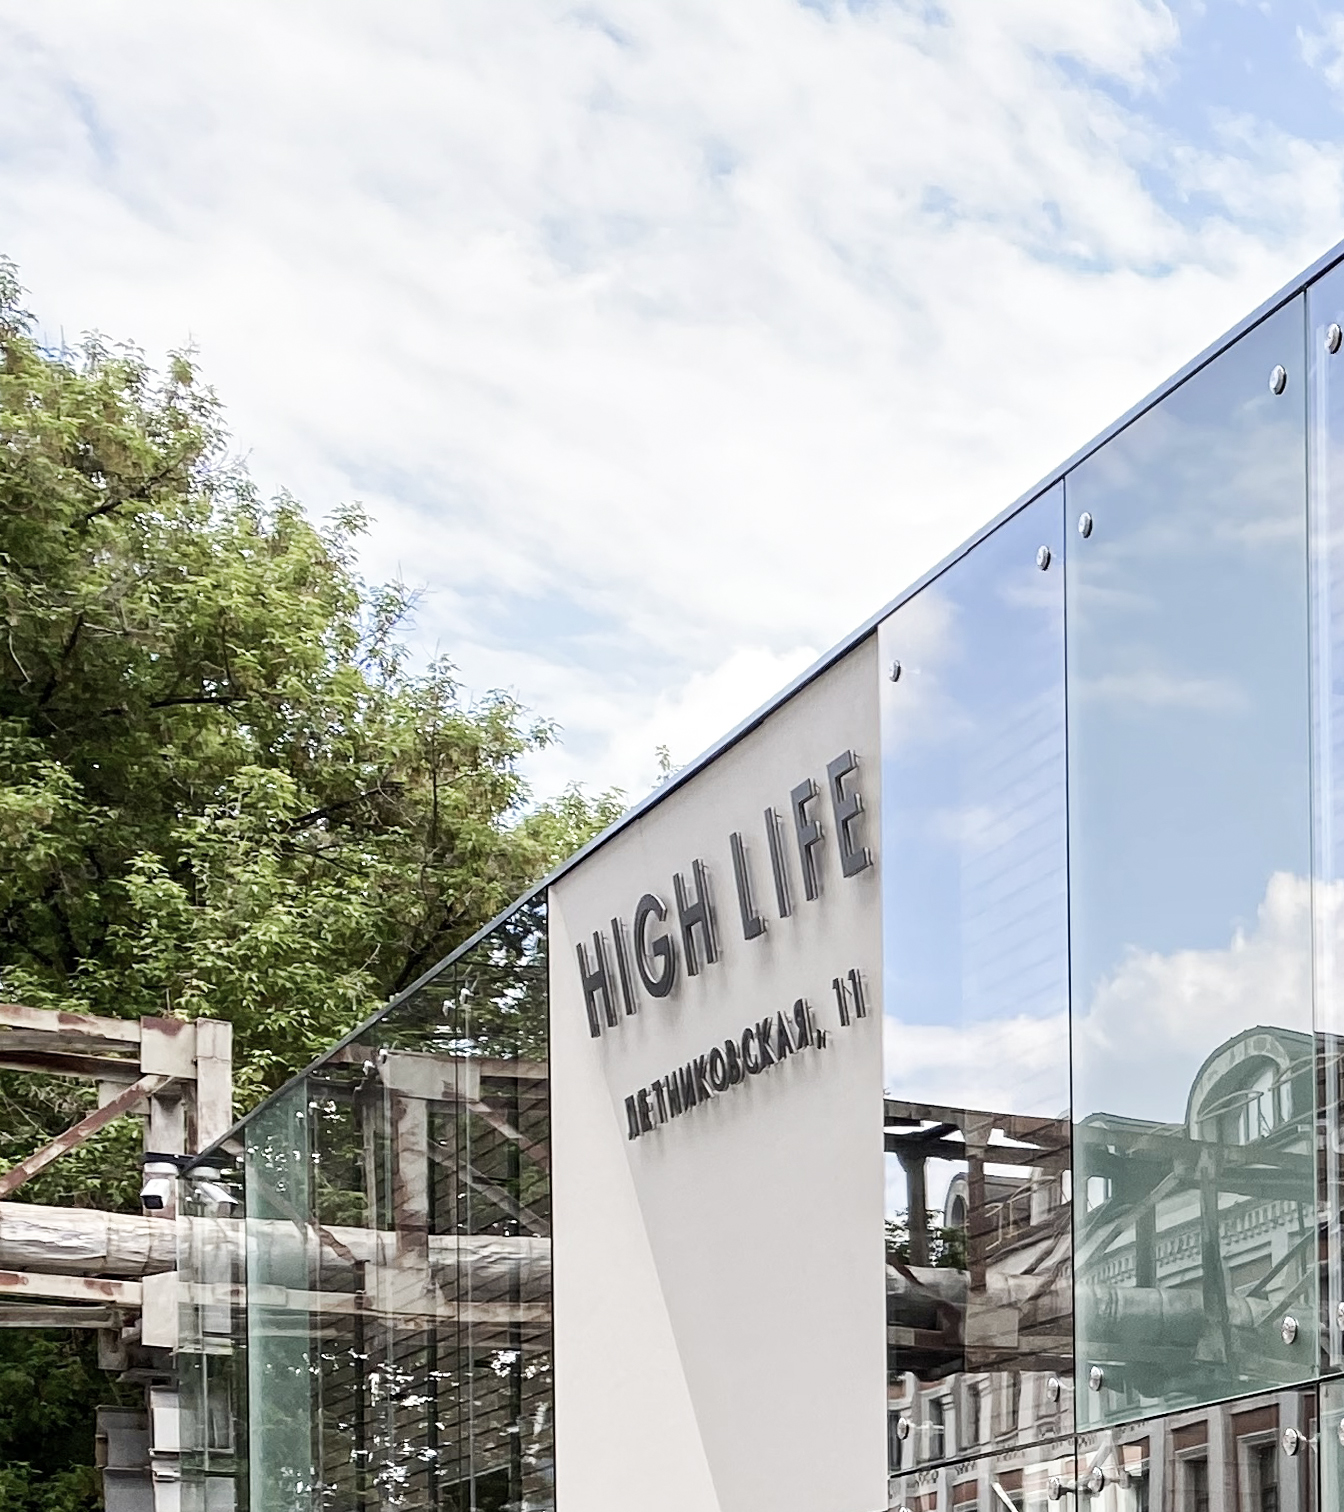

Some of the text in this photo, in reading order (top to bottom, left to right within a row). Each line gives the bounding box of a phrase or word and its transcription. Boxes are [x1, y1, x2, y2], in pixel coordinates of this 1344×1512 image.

[576, 749, 873, 1038] HIGH LIFE
[624, 968, 867, 1140] ЛЕТНИКОВСКАЯ, 11
